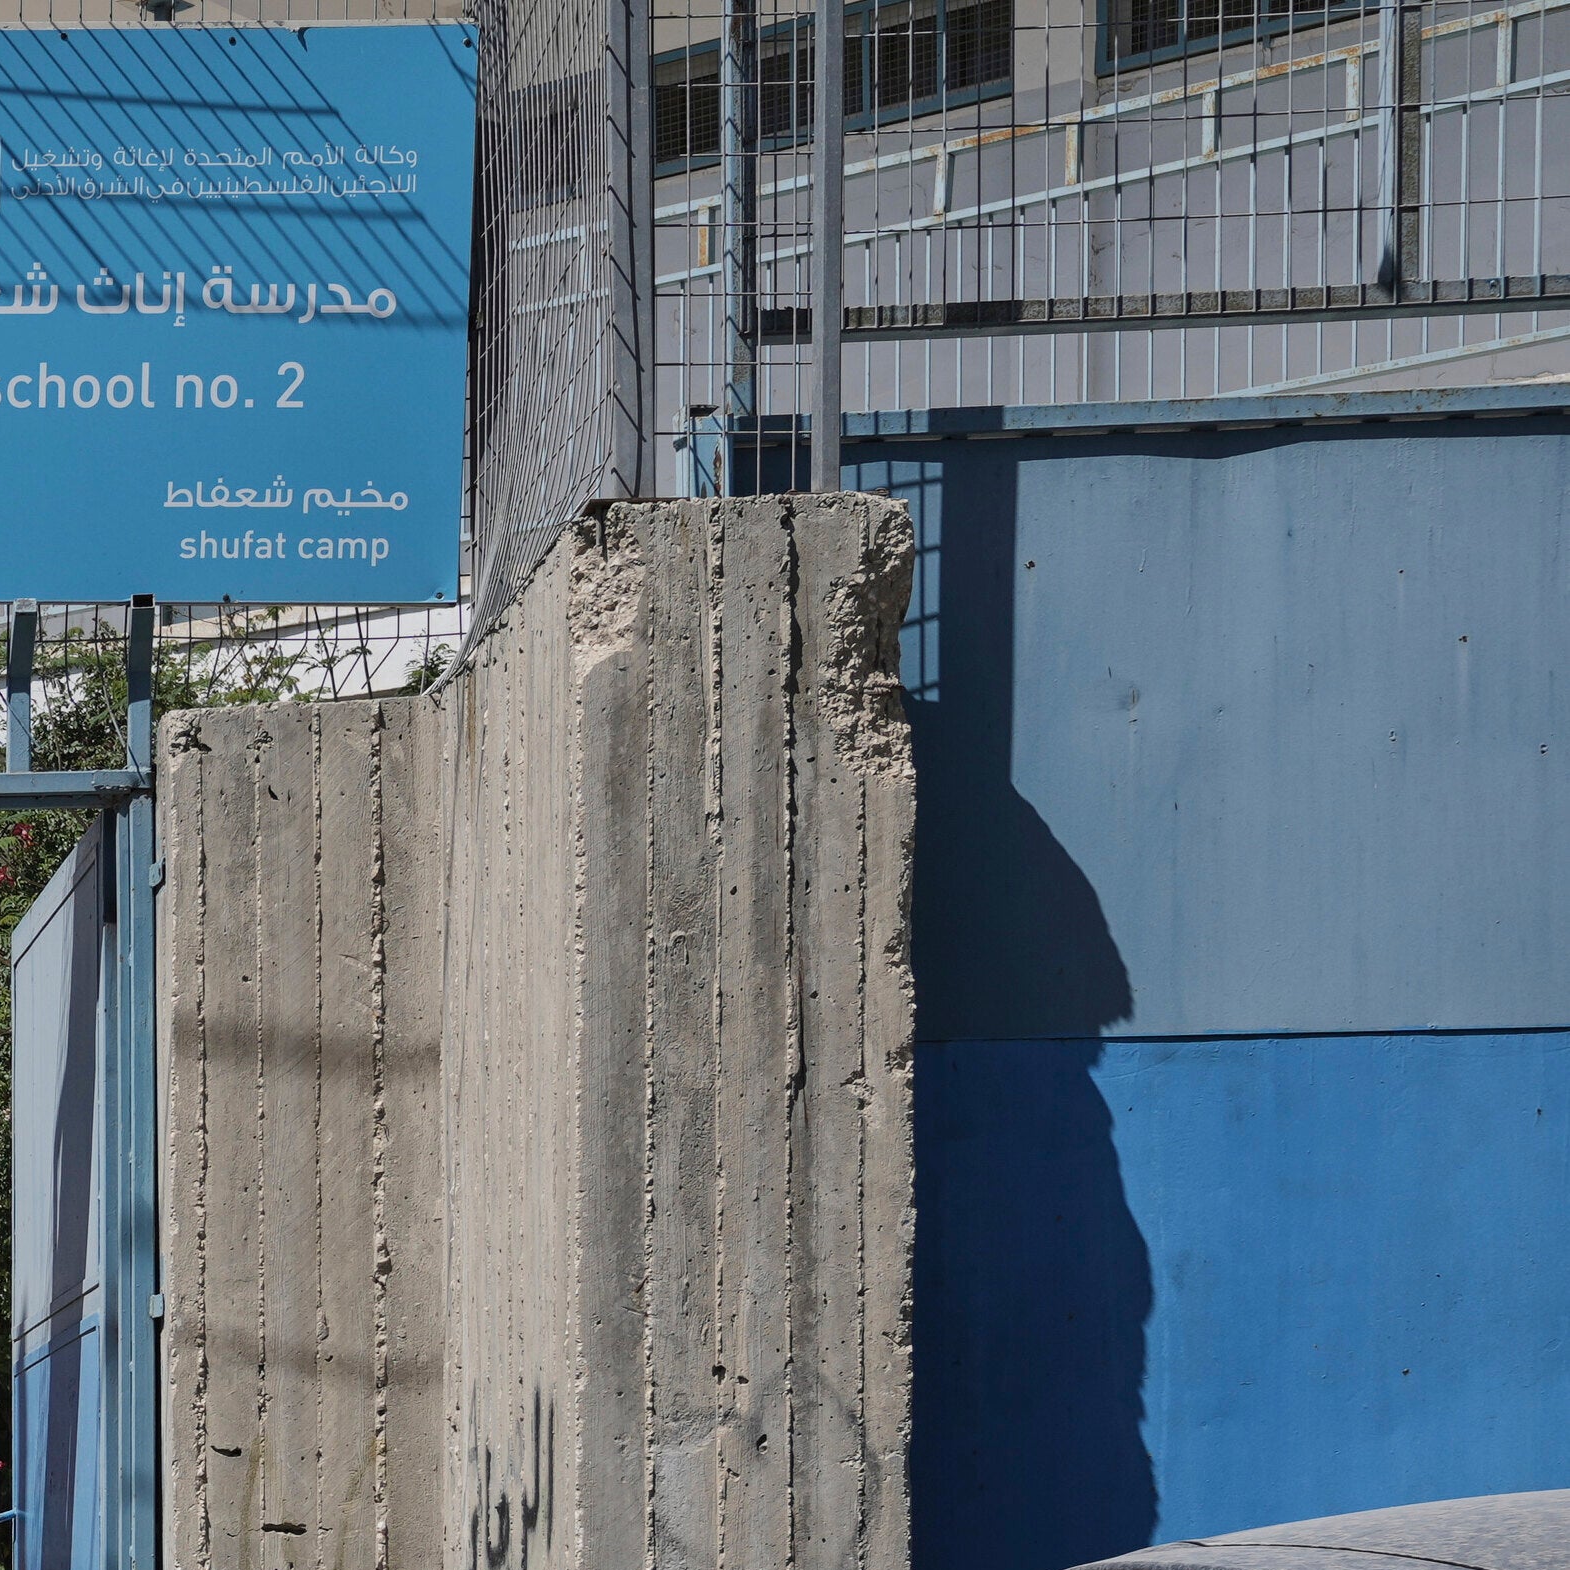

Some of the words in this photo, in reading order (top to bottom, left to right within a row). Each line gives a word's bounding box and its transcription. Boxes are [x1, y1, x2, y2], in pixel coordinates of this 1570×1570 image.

[11, 146, 103, 172] وتشغيل
[183, 146, 272, 169] المتحدة
[354, 145, 418, 169] وكالة
[77, 176, 144, 200] الشرق
[145, 177, 185, 200] في
[186, 175, 328, 199] الفلسطينيين
[330, 173, 417, 199] اللاجئين
[76, 267, 186, 327] إناث
[202, 265, 398, 324] مدرسة
[175, 374, 254, 409] no.
[276, 361, 305, 408] 2
[163, 474, 294, 508] شعفاط
[302, 480, 409, 516] مخيم
[179, 529, 287, 559] shufat
[298, 537, 390, 567] camp
